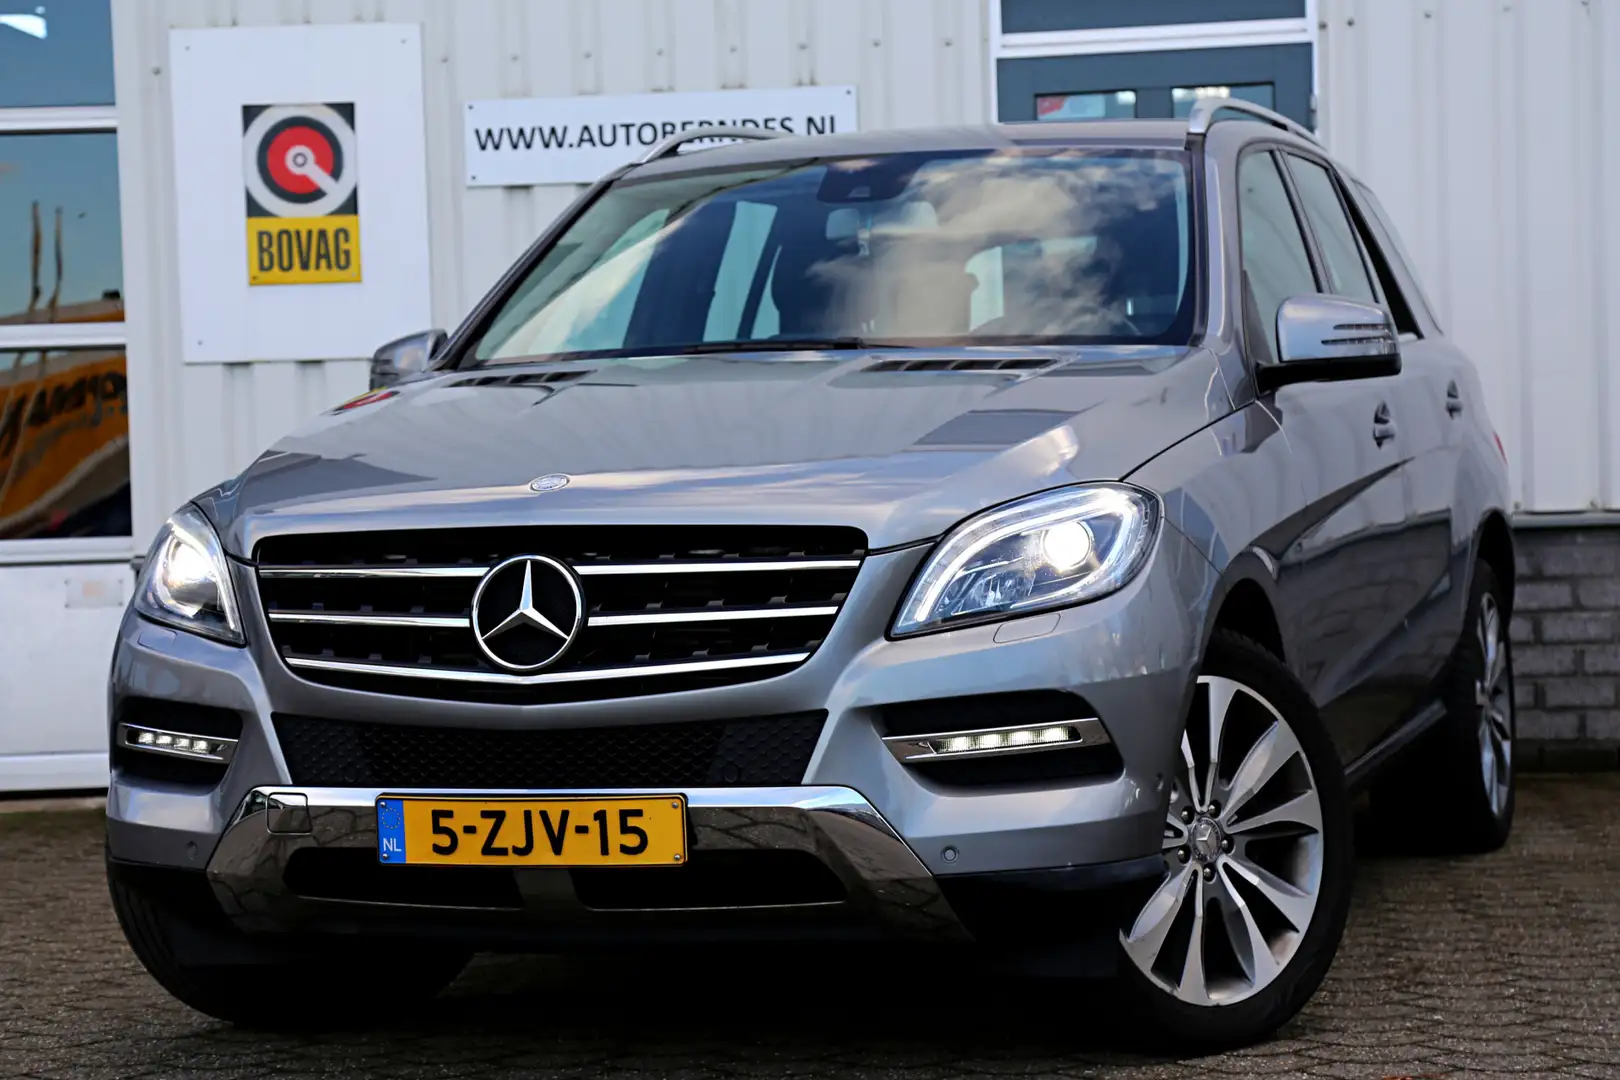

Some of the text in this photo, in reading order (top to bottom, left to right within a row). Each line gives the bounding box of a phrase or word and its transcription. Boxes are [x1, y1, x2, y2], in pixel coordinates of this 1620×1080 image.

[257, 227, 351, 272] BOVAG
[383, 837, 402, 852] NL
[431, 809, 649, 857] 5-ZJV-15
